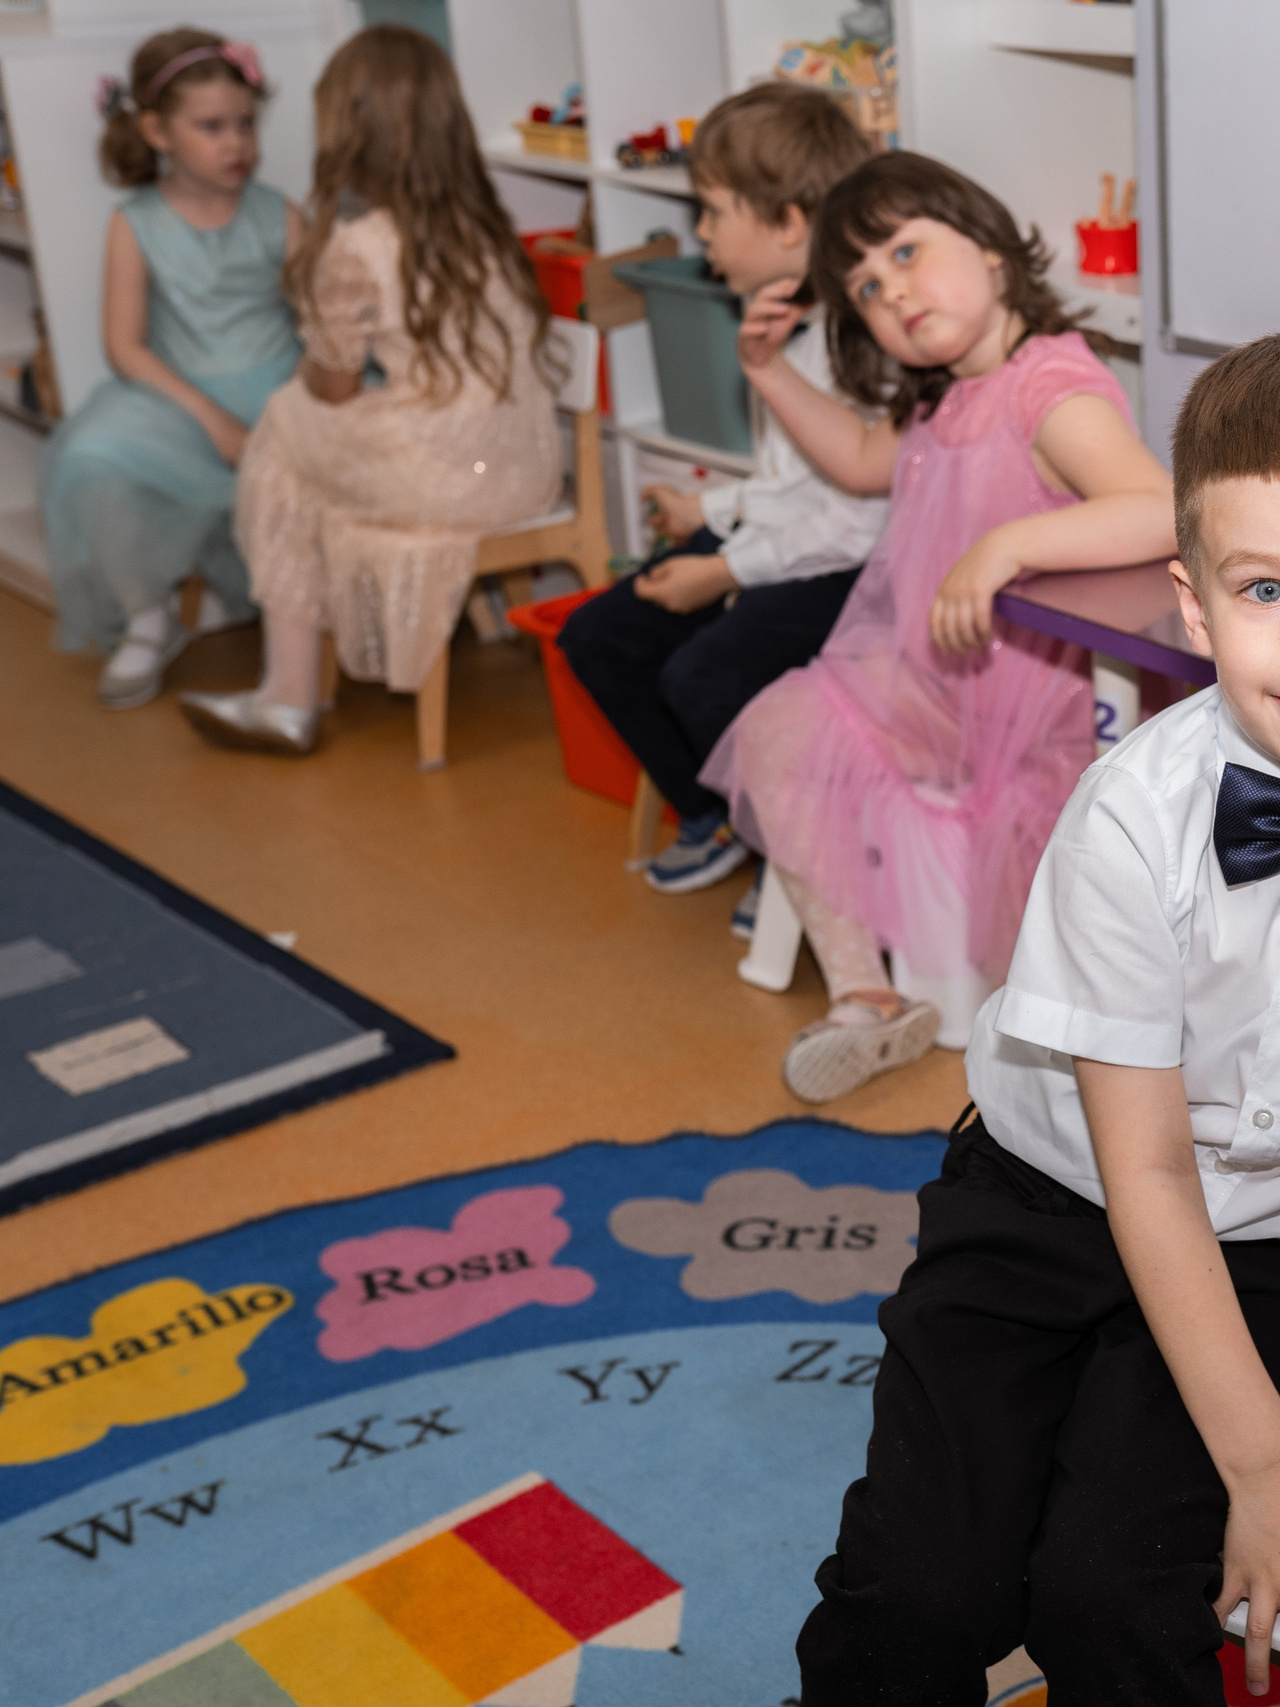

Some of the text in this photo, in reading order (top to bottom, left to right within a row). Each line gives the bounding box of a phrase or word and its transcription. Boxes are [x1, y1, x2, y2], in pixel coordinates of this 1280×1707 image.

[1094, 700, 1117, 742] 2
[720, 1215, 880, 1252] Gris
[355, 1243, 537, 1304] Rosa
[0, 1287, 287, 1406] Amarillo
[775, 1340, 883, 1387] Zz
[557, 1359, 682, 1404] Yy
[317, 1406, 466, 1474] Xx
[40, 1480, 229, 1563] Ww
